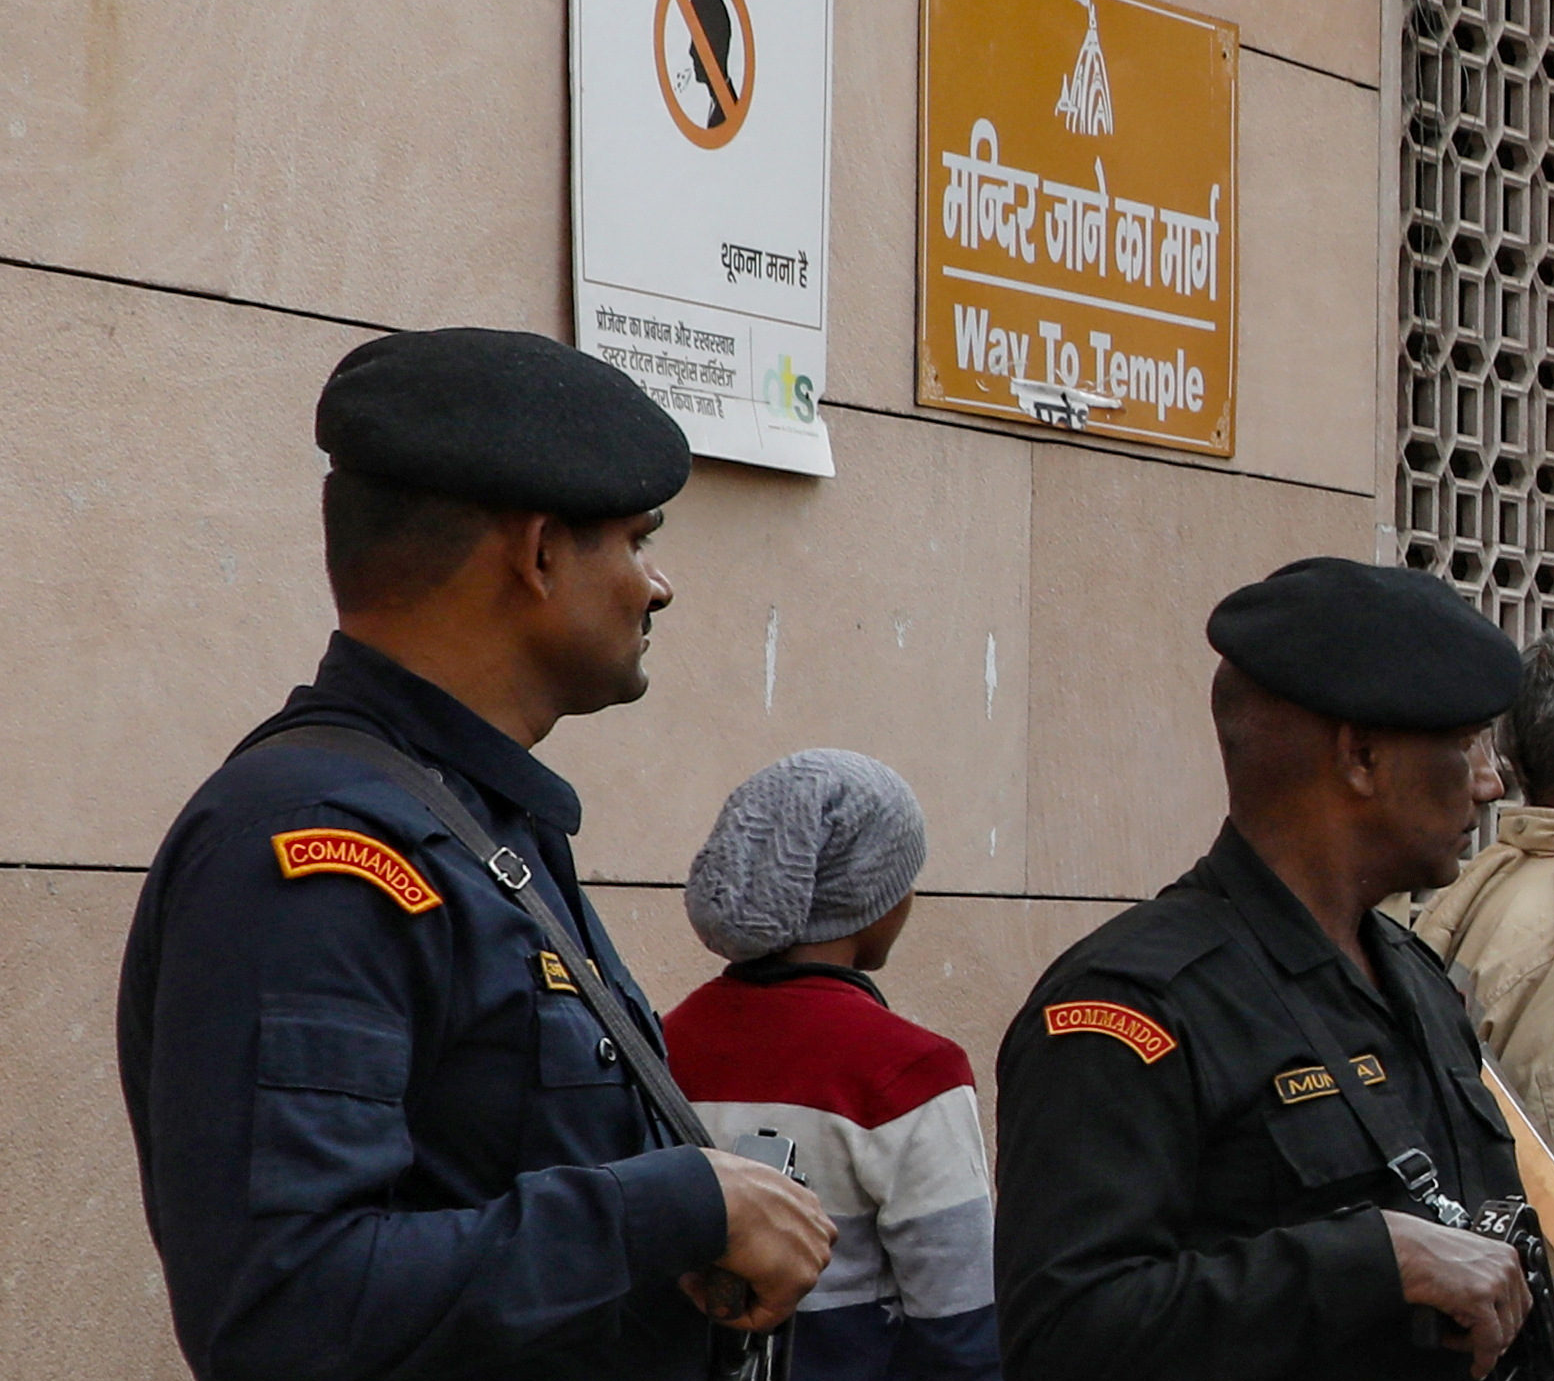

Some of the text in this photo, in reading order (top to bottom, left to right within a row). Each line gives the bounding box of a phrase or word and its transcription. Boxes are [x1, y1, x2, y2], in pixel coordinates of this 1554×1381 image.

[942, 118, 1220, 301] मन्दिर जाने का मार्ग
[721, 242, 808, 288] थूकना मना है
[628, 316, 641, 337] का
[674, 320, 691, 348] और
[954, 304, 1030, 378] Way
[1039, 320, 1080, 388] To
[1090, 330, 1204, 421] Temple
[669, 385, 693, 414] किया
[695, 396, 715, 417] जाता
[715, 394, 724, 420] है
[763, 354, 815, 423] dts
[290, 840, 422, 903] COMMANDO
[1055, 1009, 1162, 1053] COMMANDO
[1288, 1063, 1375, 1095] MUNA
[1476, 1210, 1510, 1233] 36
